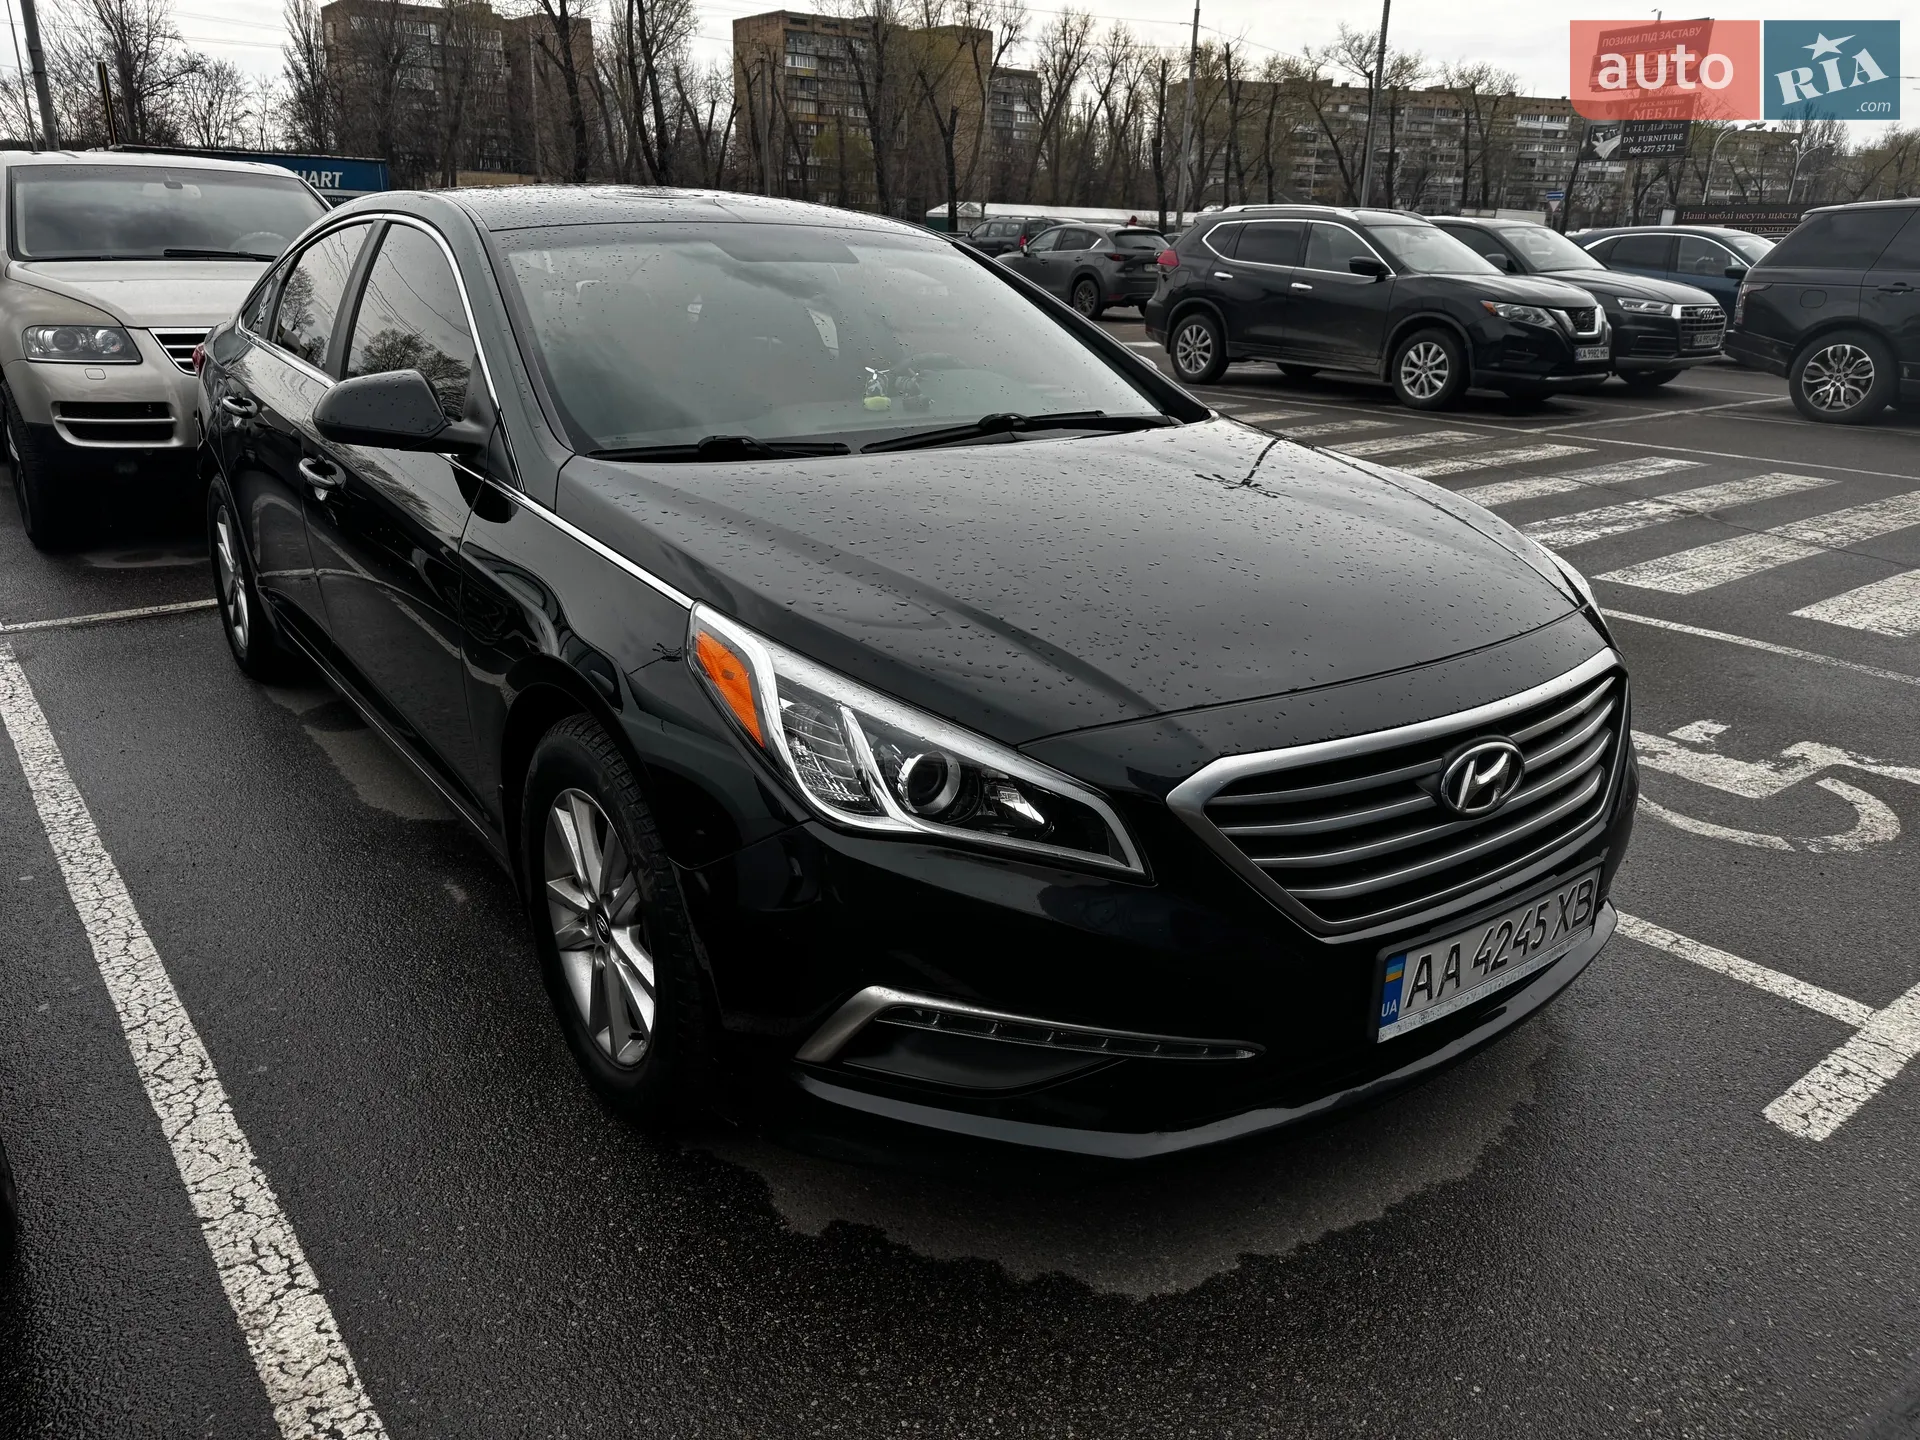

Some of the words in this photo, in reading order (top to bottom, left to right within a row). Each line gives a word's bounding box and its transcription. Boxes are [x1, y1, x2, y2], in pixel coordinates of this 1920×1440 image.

[1602, 34, 1639, 47] ПОЗИКИ
[1641, 32, 1657, 43] ПІД
[1659, 26, 1702, 40] ЗАСТАВУ
[1633, 106, 1680, 121] МЕБЛІ
[1638, 133, 1684, 142] FURNITURE
[1629, 146, 1641, 154] 066
[1642, 145, 1656, 153] 277
[1656, 144, 1665, 152] 57
[1666, 144, 1675, 152] 21
[1682, 211, 1707, 220] Наші
[1707, 211, 1734, 220] меблі
[1735, 212, 1766, 222] несуть
[1768, 212, 1798, 220] щастя
[1404, 941, 1461, 1009] AA
[1470, 898, 1551, 976] 4245
[1550, 877, 1594, 941] XB
[1381, 999, 1397, 1018] UA
